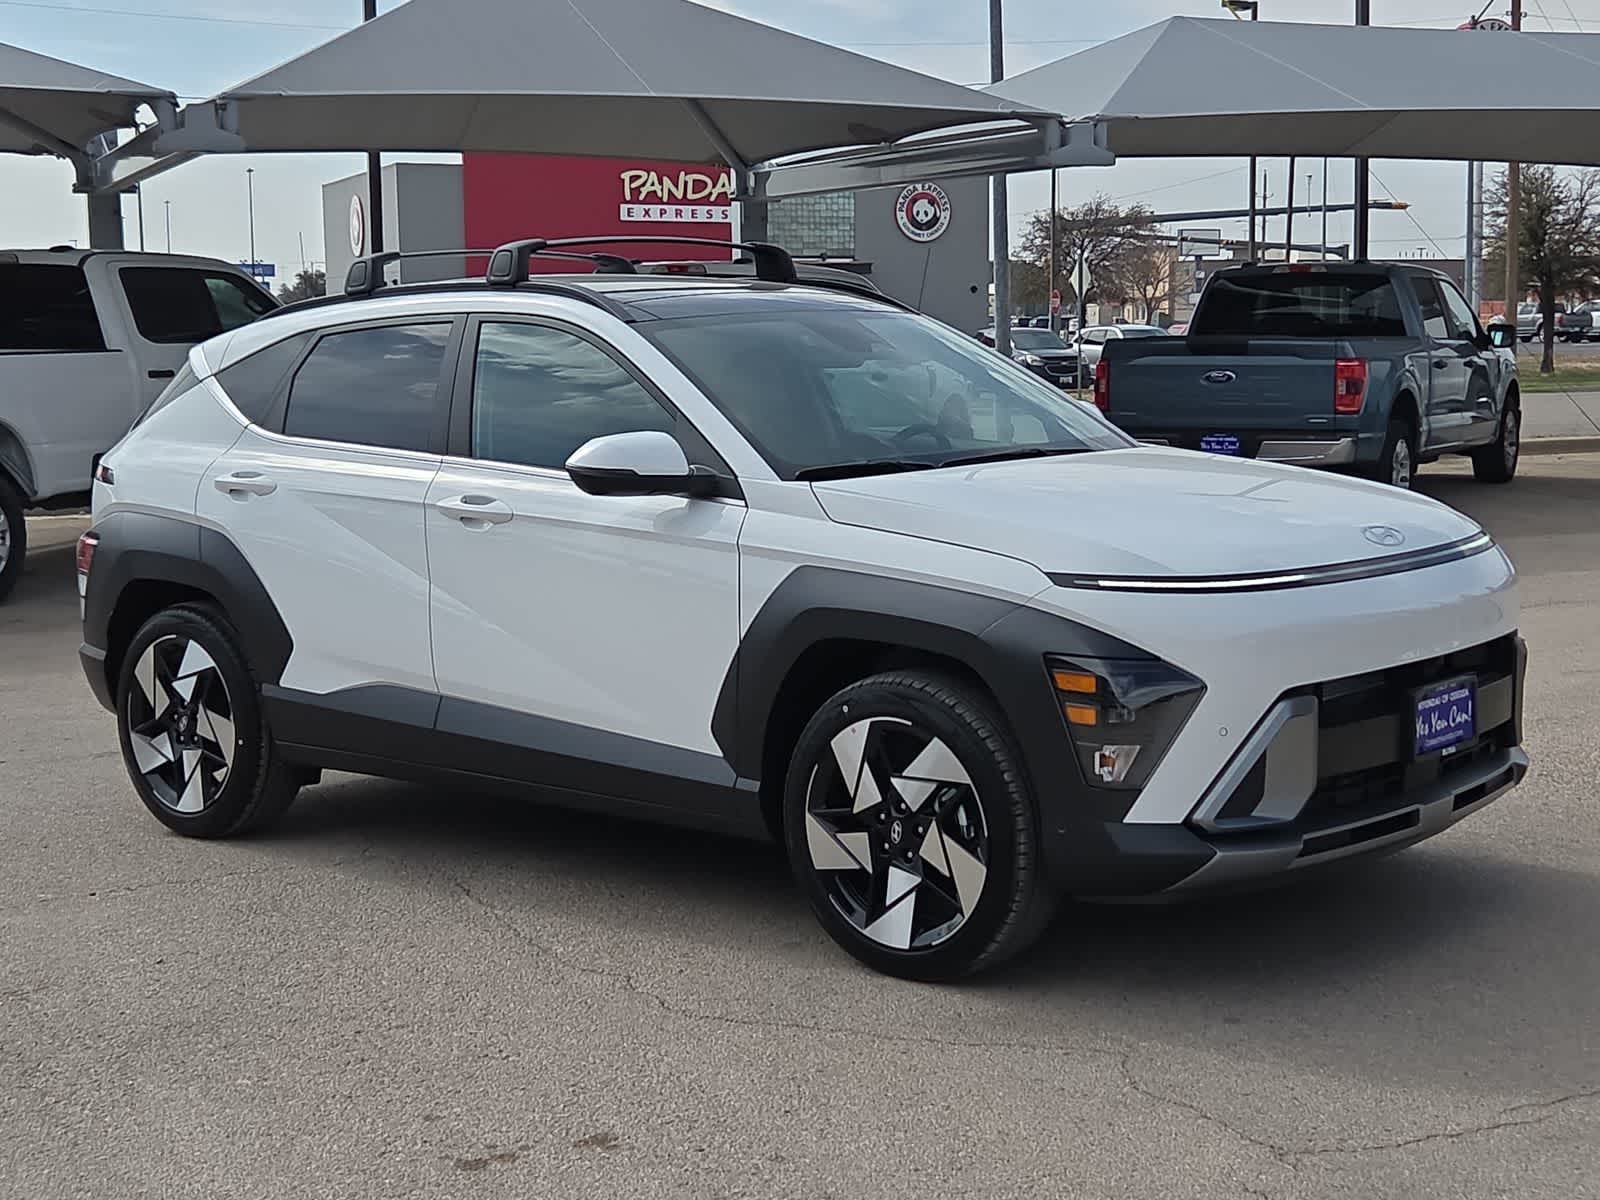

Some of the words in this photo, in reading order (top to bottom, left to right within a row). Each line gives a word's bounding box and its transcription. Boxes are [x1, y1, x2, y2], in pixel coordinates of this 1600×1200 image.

[620, 170, 731, 202] PANDA
[898, 185, 919, 212] PANDA
[922, 184, 949, 212] EXPRESS
[626, 207, 728, 219] EXPRESS
[1431, 712, 1448, 733] You
[1449, 700, 1471, 727] Can!
